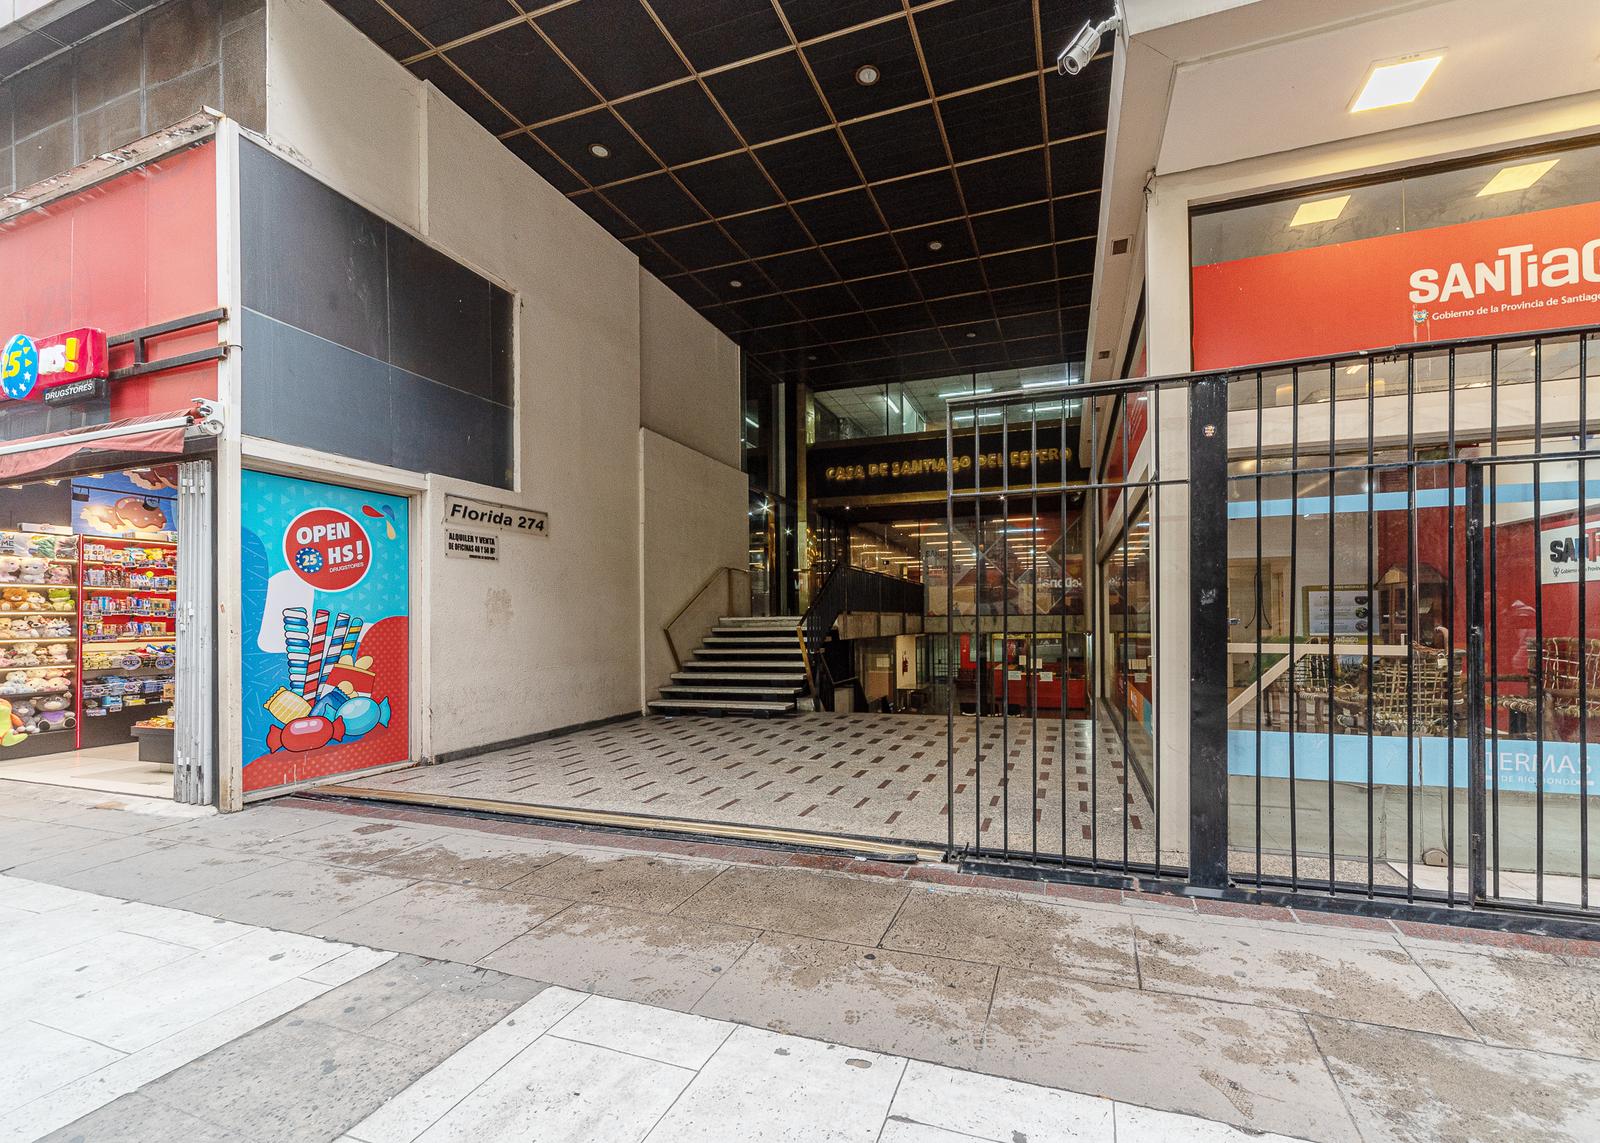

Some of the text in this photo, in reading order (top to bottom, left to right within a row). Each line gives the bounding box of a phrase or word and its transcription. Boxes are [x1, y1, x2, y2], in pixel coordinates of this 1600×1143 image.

[1432, 309, 1475, 321] Gobierno
[1476, 306, 1489, 315] de
[1490, 305, 1499, 313] la
[1501, 300, 1544, 312] Provincia
[1546, 297, 1559, 306] de
[46, 383, 93, 400] DRUGSTORES
[825, 465, 866, 480] CASA
[868, 462, 889, 477] DE
[450, 504, 545, 531] Florida 274
[296, 521, 351, 545] OPEN
[449, 533, 474, 542] ALQUILER
[479, 537, 495, 545] VENTA
[302, 540, 364, 566] 25 HS!
[449, 542, 453, 550] DE
[455, 543, 473, 552] OFICINAS
[329, 562, 364, 573] DRUGSTORES
[1485, 752, 1593, 774] TERMAS
